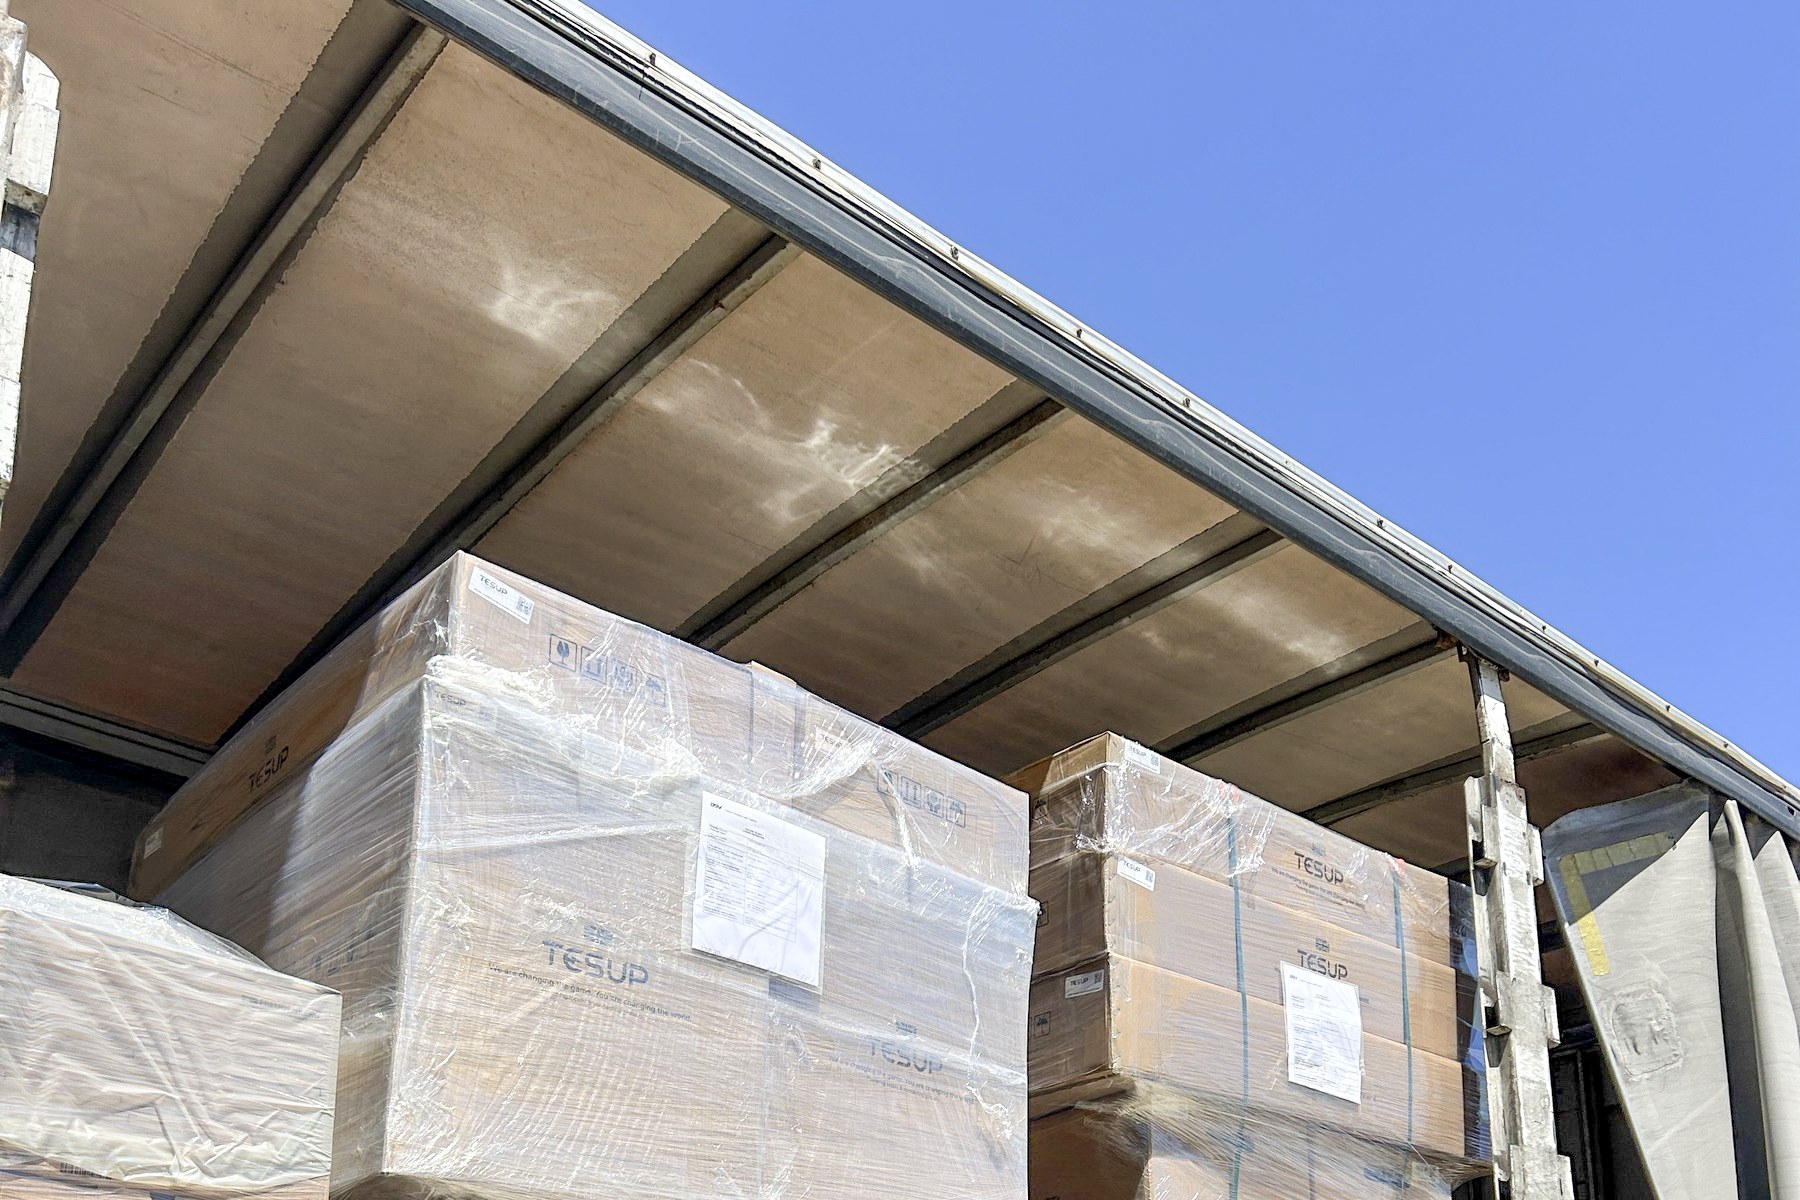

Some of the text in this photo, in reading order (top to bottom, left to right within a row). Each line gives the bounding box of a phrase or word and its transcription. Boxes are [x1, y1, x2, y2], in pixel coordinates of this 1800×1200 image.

[480, 575, 508, 595] TESUP
[249, 745, 290, 791] TESUP
[1294, 851, 1344, 884] TESUP
[542, 939, 649, 986] TESUP
[1297, 948, 1348, 980] TESUP
[866, 1035, 943, 1075] TESUP
